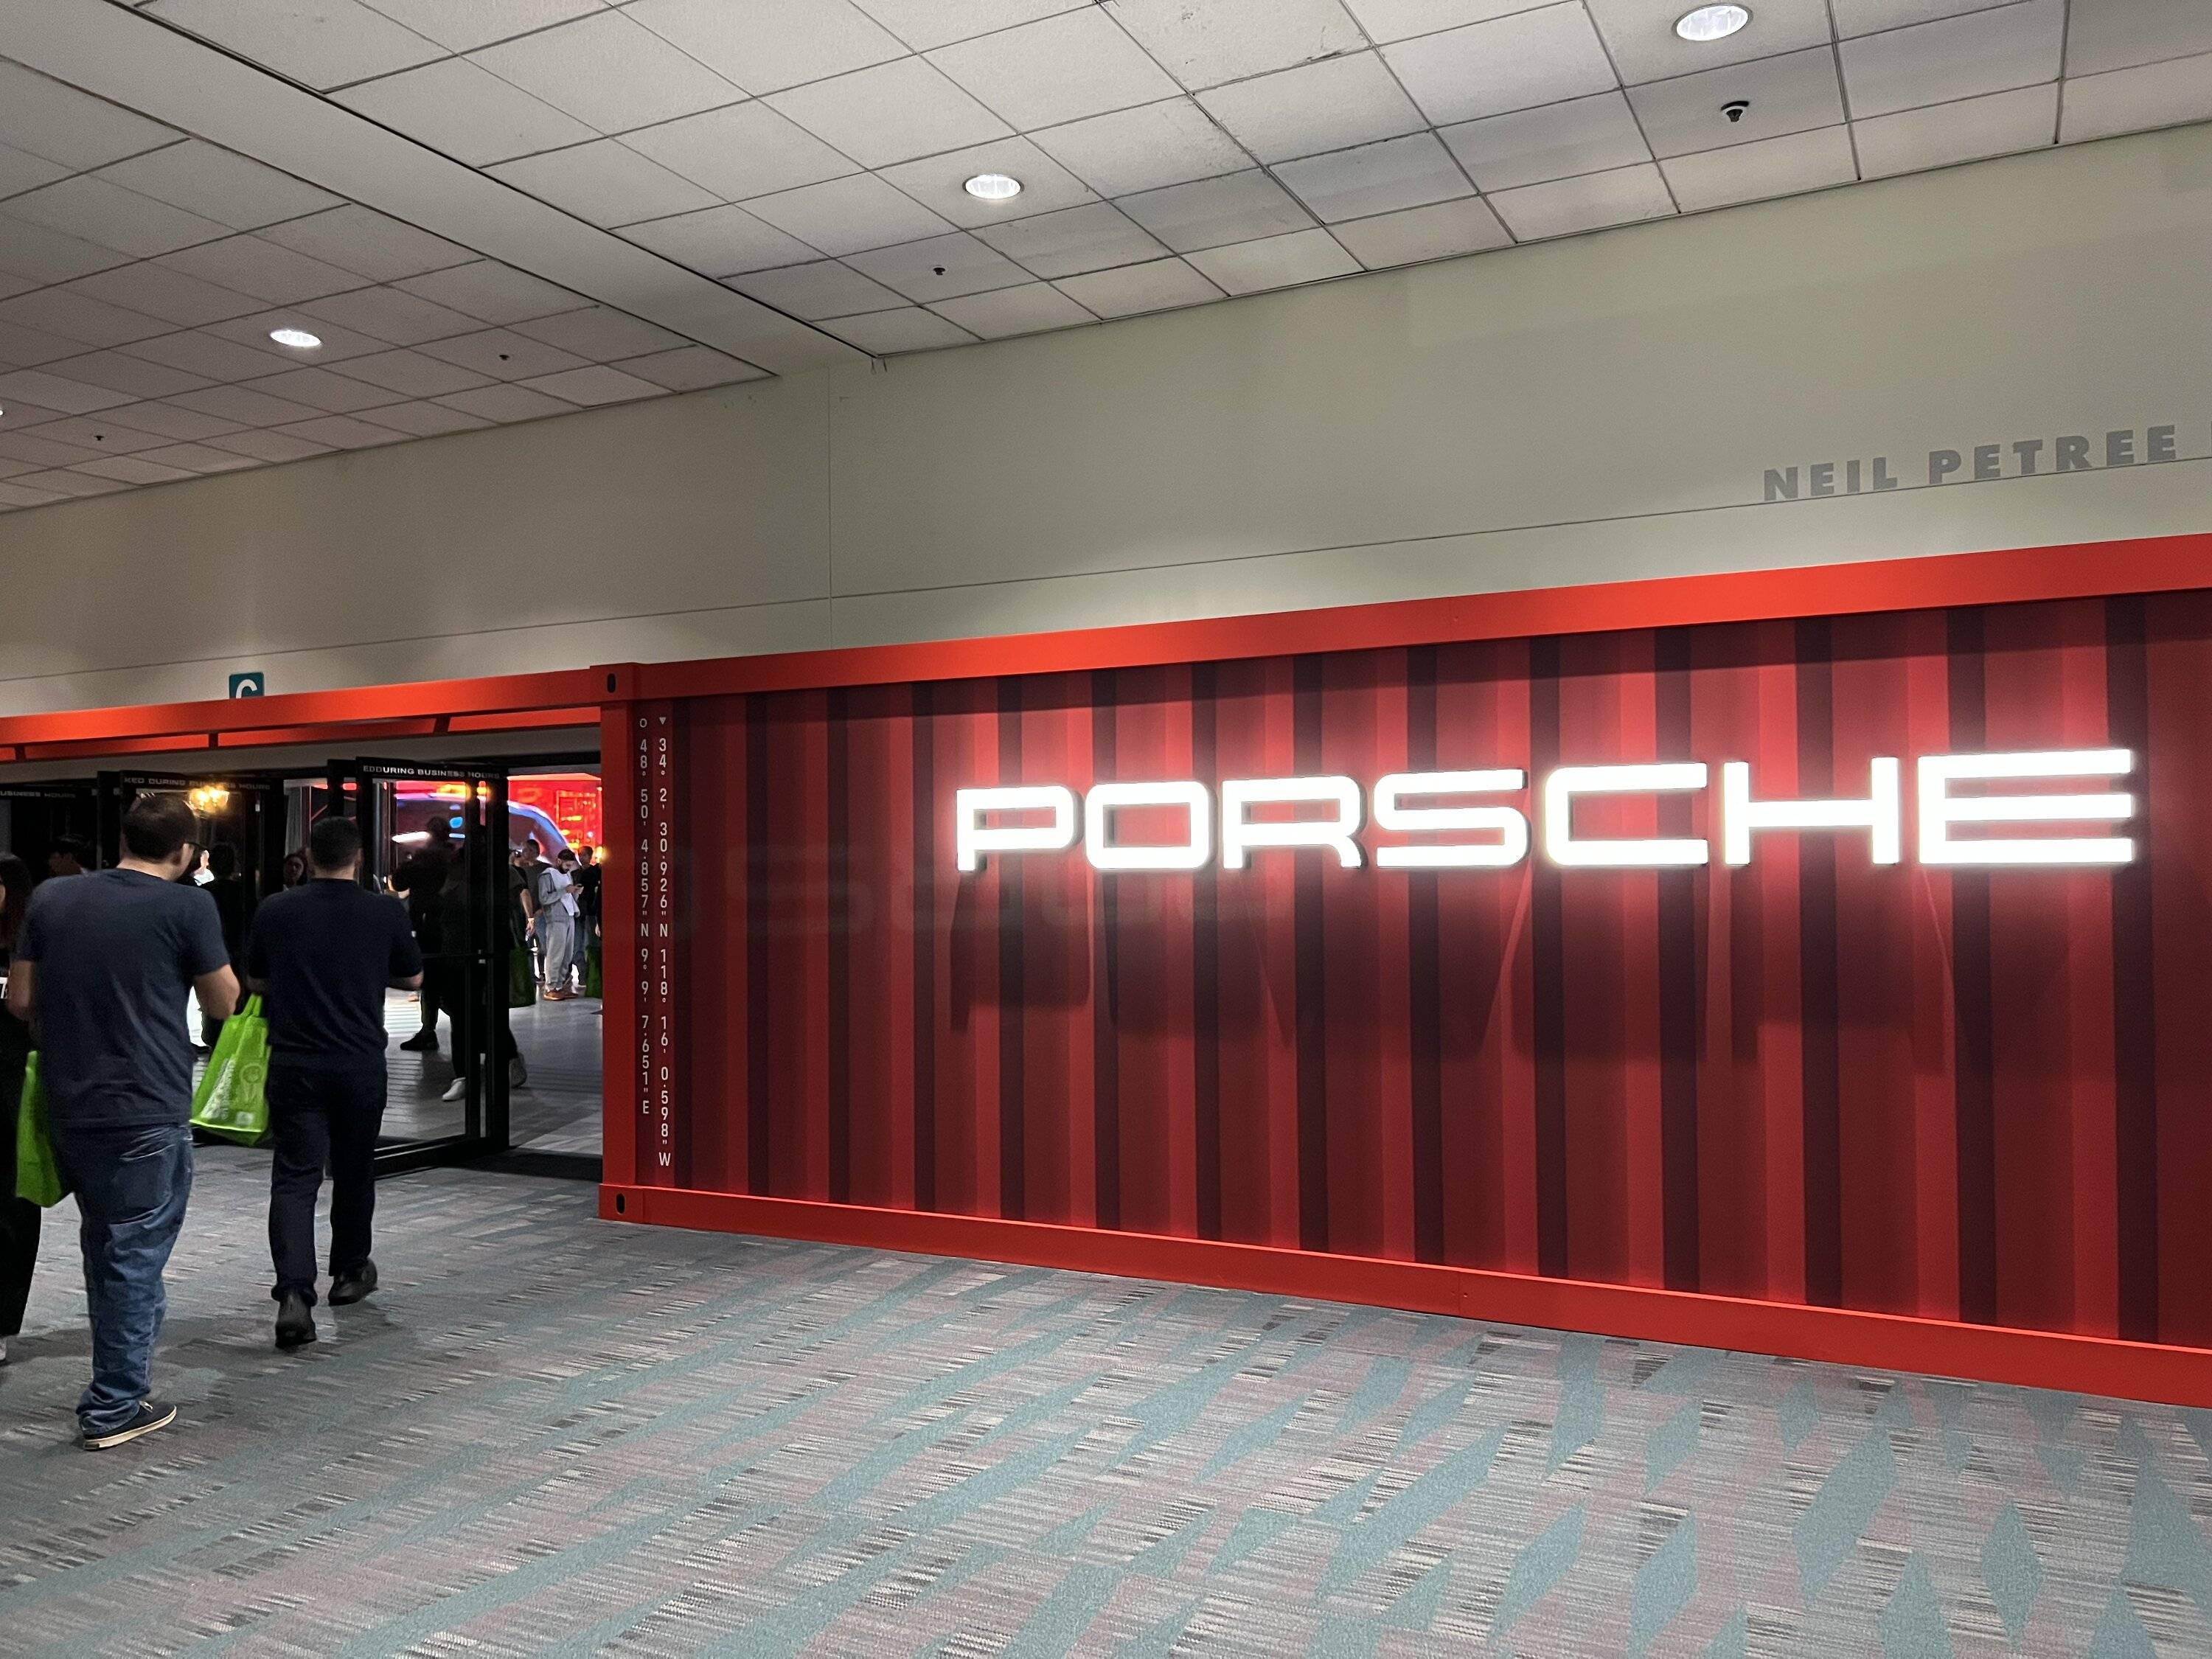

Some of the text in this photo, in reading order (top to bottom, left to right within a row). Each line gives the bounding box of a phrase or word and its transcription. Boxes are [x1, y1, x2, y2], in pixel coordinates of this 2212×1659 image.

[1763, 424, 2177, 502] NEIL PETREE
[417, 768, 465, 777] BUSINESS
[956, 748, 2134, 871] PORSCHE
